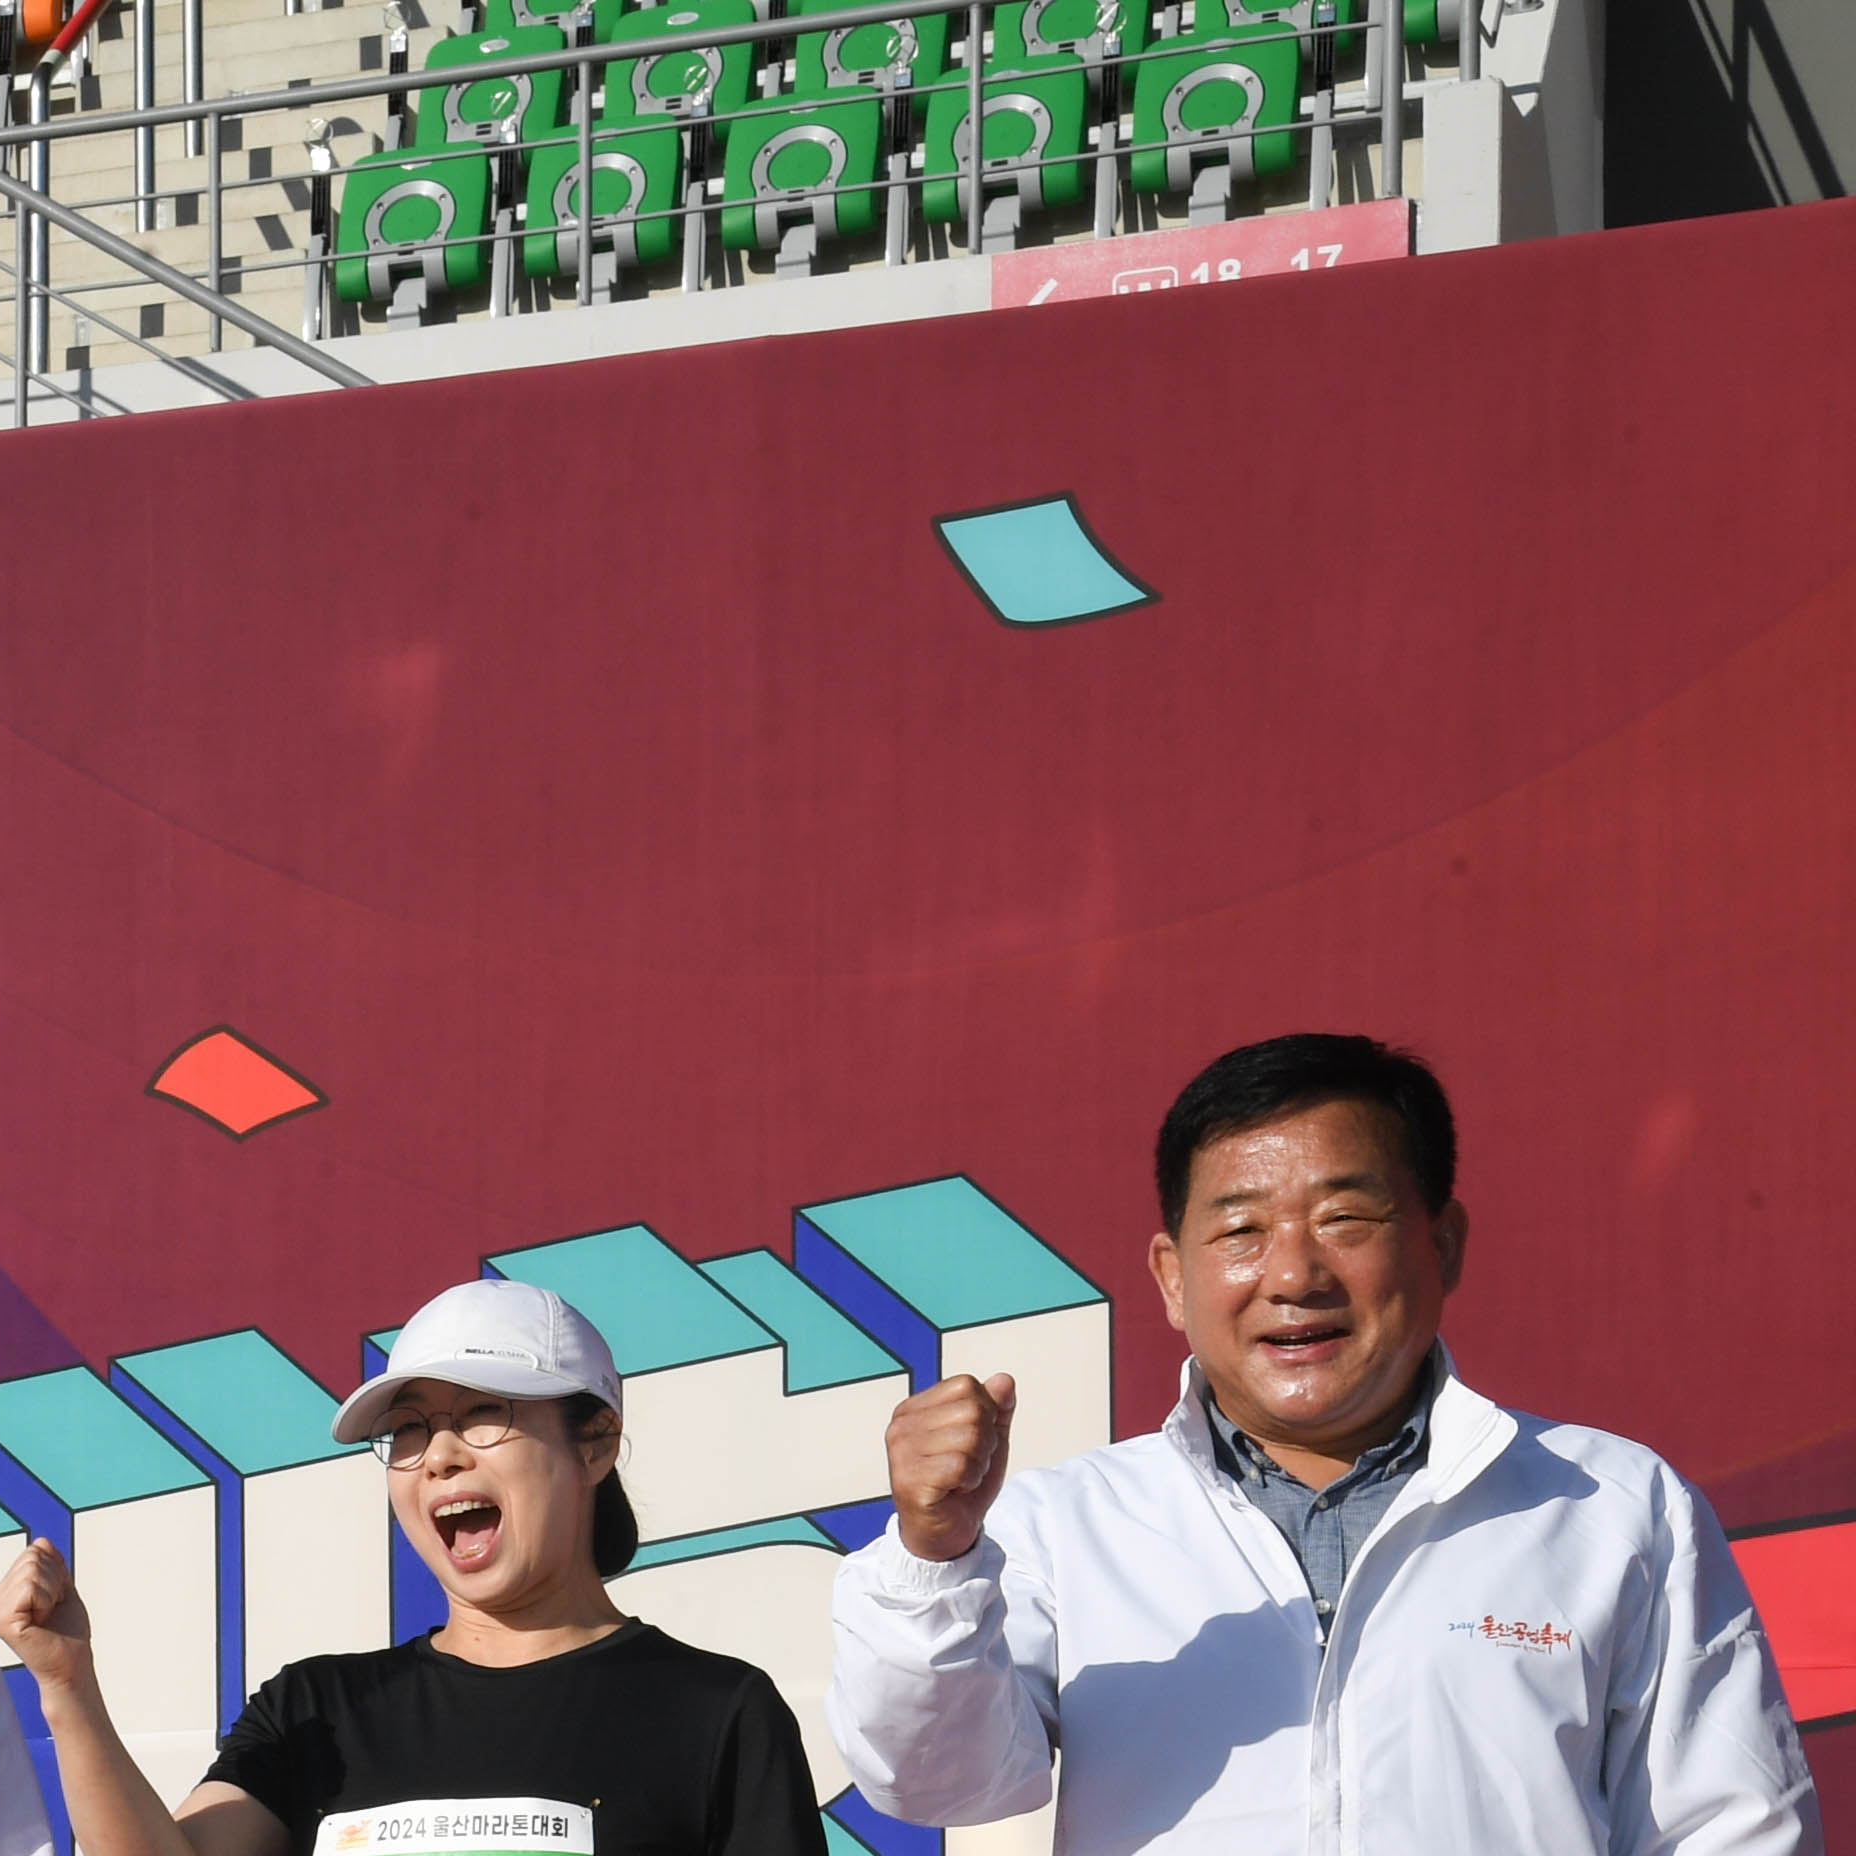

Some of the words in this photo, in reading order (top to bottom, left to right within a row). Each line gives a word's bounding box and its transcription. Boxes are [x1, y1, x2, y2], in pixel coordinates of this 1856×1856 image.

[1478, 1615, 1571, 1654] 울산공업축제
[377, 1818, 426, 1841] 2024
[432, 1814, 568, 1838] 울산마라톤대회
